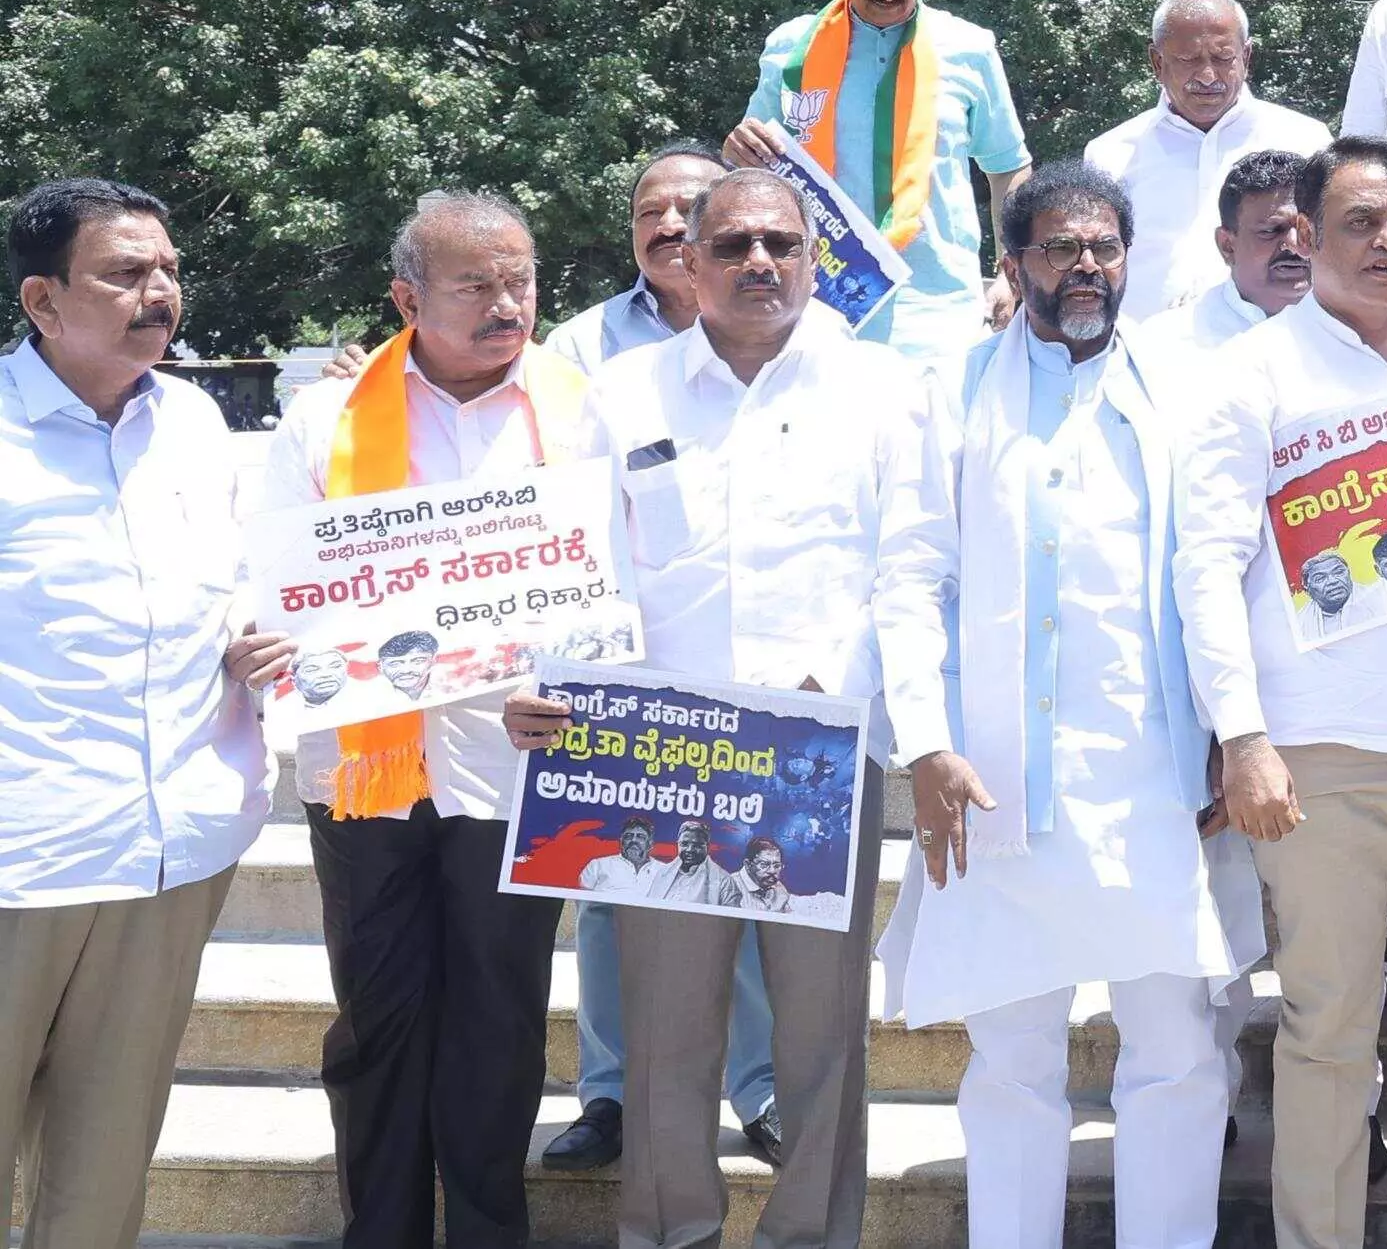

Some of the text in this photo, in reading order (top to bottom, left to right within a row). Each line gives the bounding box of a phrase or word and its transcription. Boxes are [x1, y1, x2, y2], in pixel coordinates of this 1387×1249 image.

[280, 528, 599, 613] ಕಾಂಗ್ರೆಸ್ ಸರ್ಕಾರಕ್ಕೆ
[436, 594, 516, 631] ಧಿಕ್ಕಾರ
[642, 699, 739, 733] ಸರ್ಕಾರದ
[633, 727, 775, 782] ವೈಫಲ್ಯದಿಂದ
[536, 769, 764, 823] ಅಮಾಯಕರು ಬಲಿ
